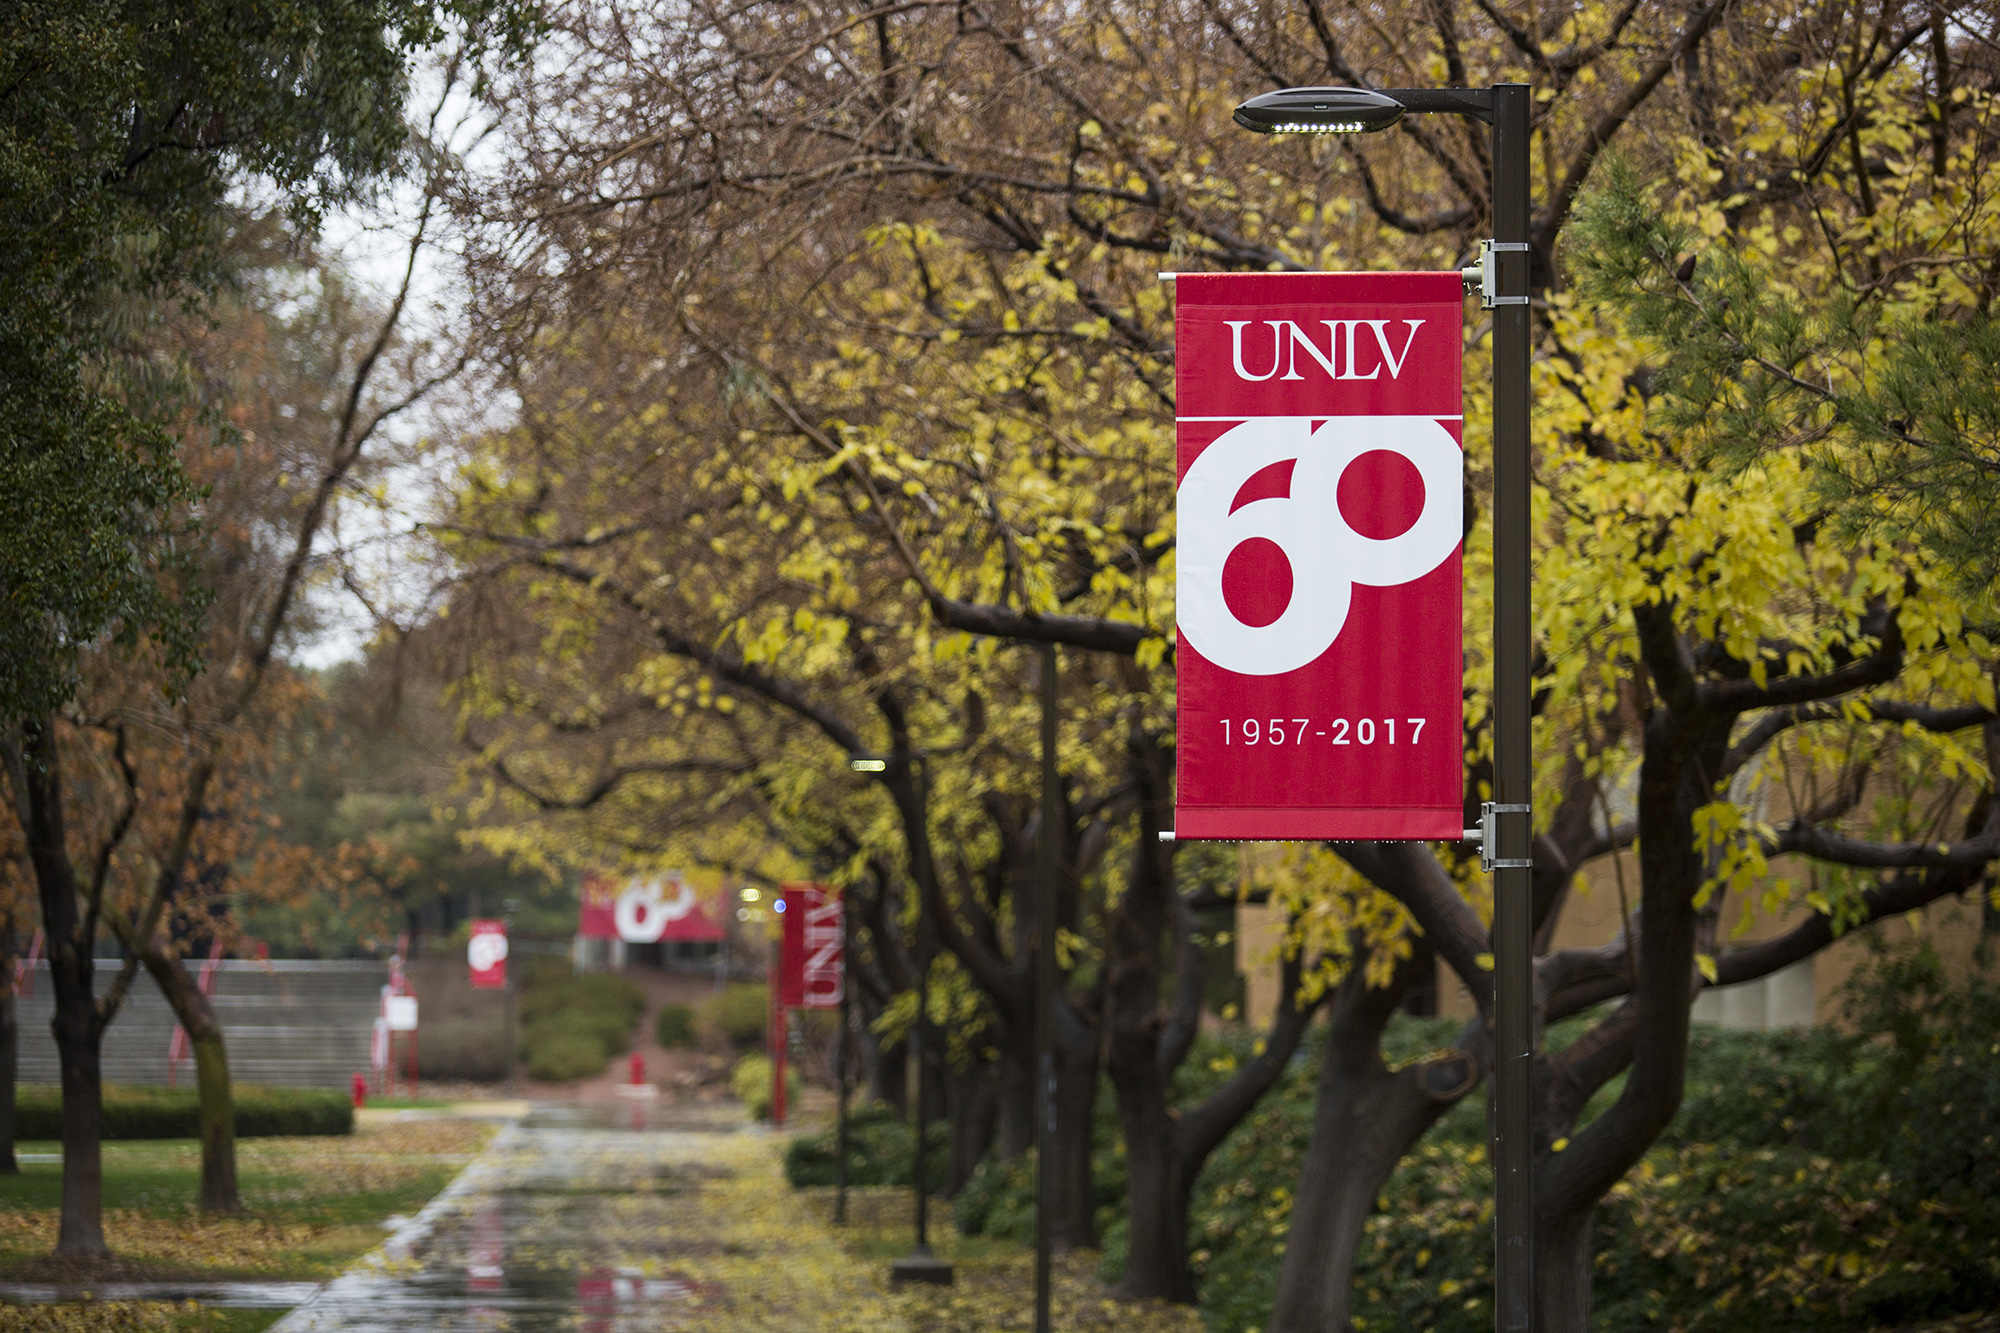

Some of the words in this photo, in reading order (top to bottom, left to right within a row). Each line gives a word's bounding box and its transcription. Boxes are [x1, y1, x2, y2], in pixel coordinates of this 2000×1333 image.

[1223, 320, 1426, 381] UNLV
[1177, 416, 1463, 675] 60
[1220, 718, 1426, 745] 1957-2017
[803, 889, 846, 1007] UNLV
